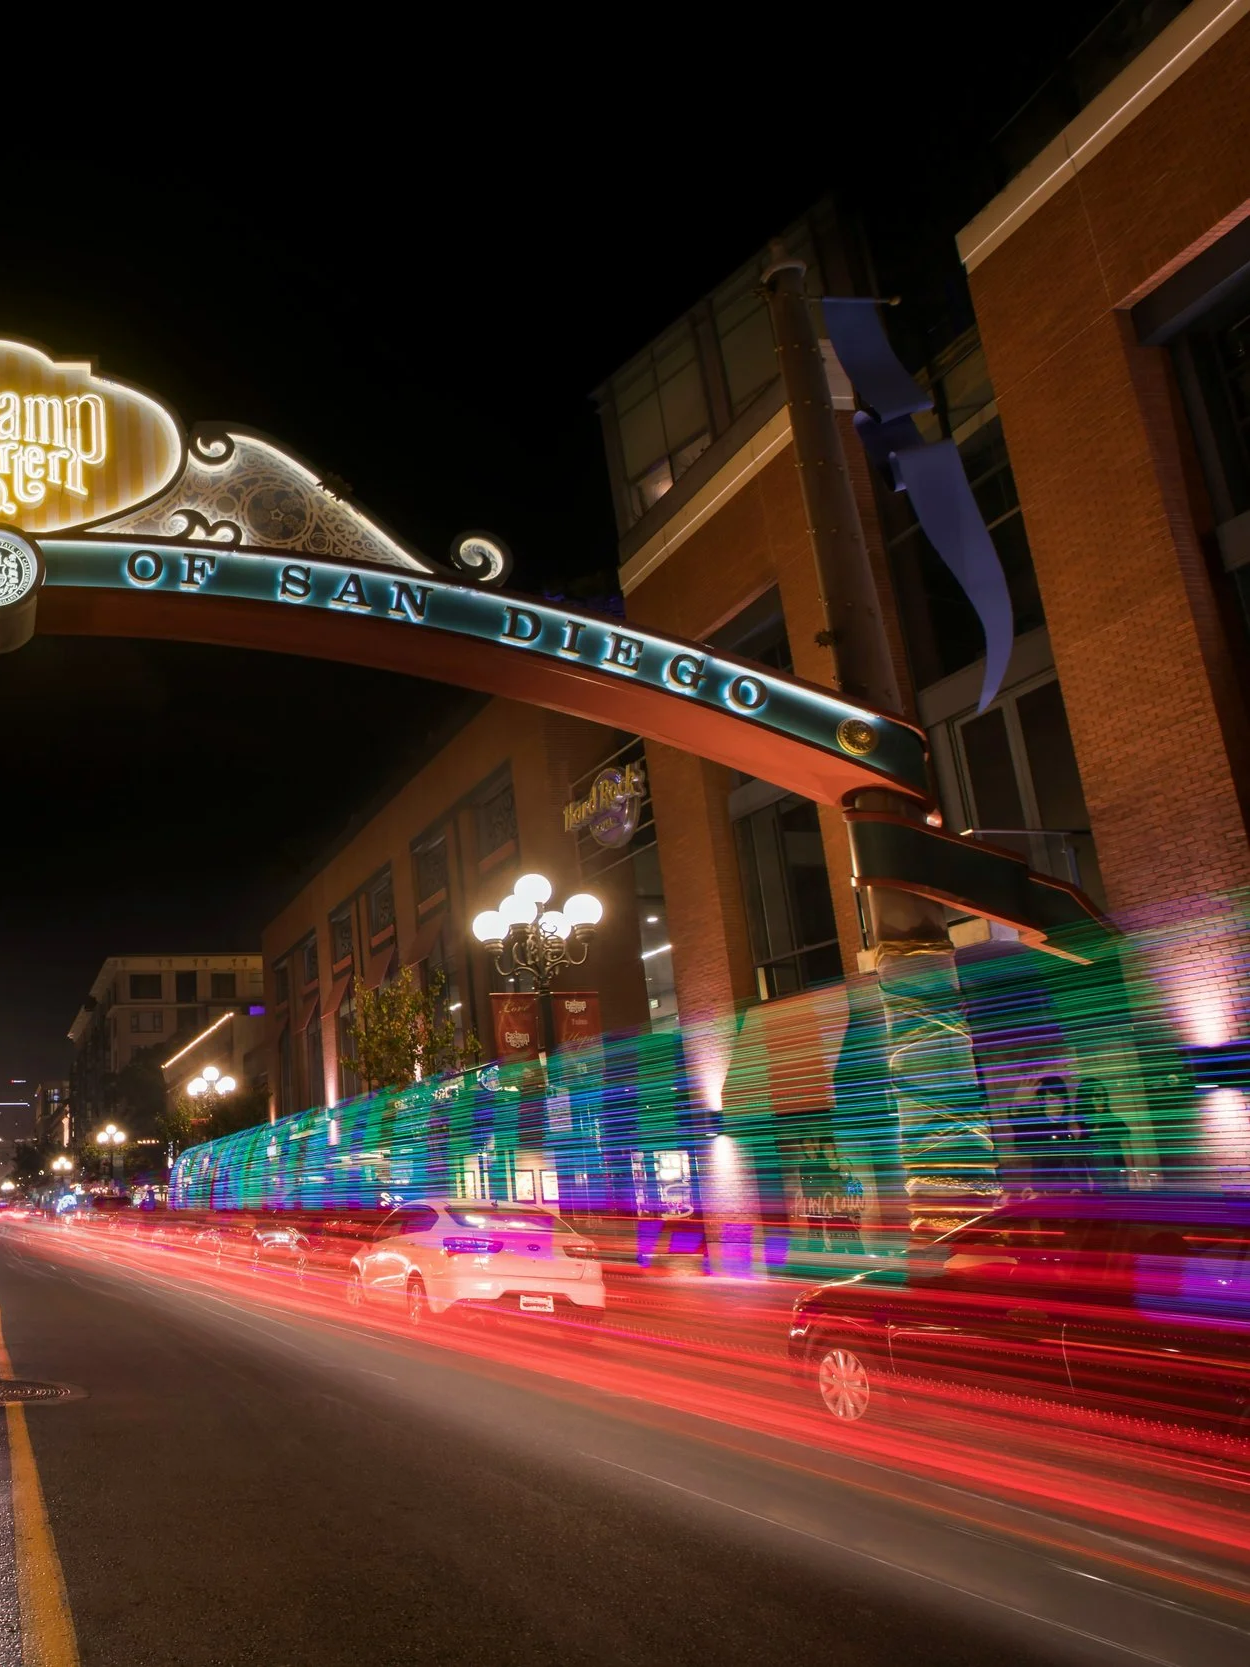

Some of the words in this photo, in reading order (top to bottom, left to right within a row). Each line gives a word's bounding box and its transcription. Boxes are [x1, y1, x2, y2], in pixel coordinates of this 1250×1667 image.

[126, 550, 216, 587] OF
[280, 564, 434, 621] SAN
[502, 605, 769, 711] DIEGO
[563, 786, 597, 832] Hard
[600, 764, 636, 808] Rock
